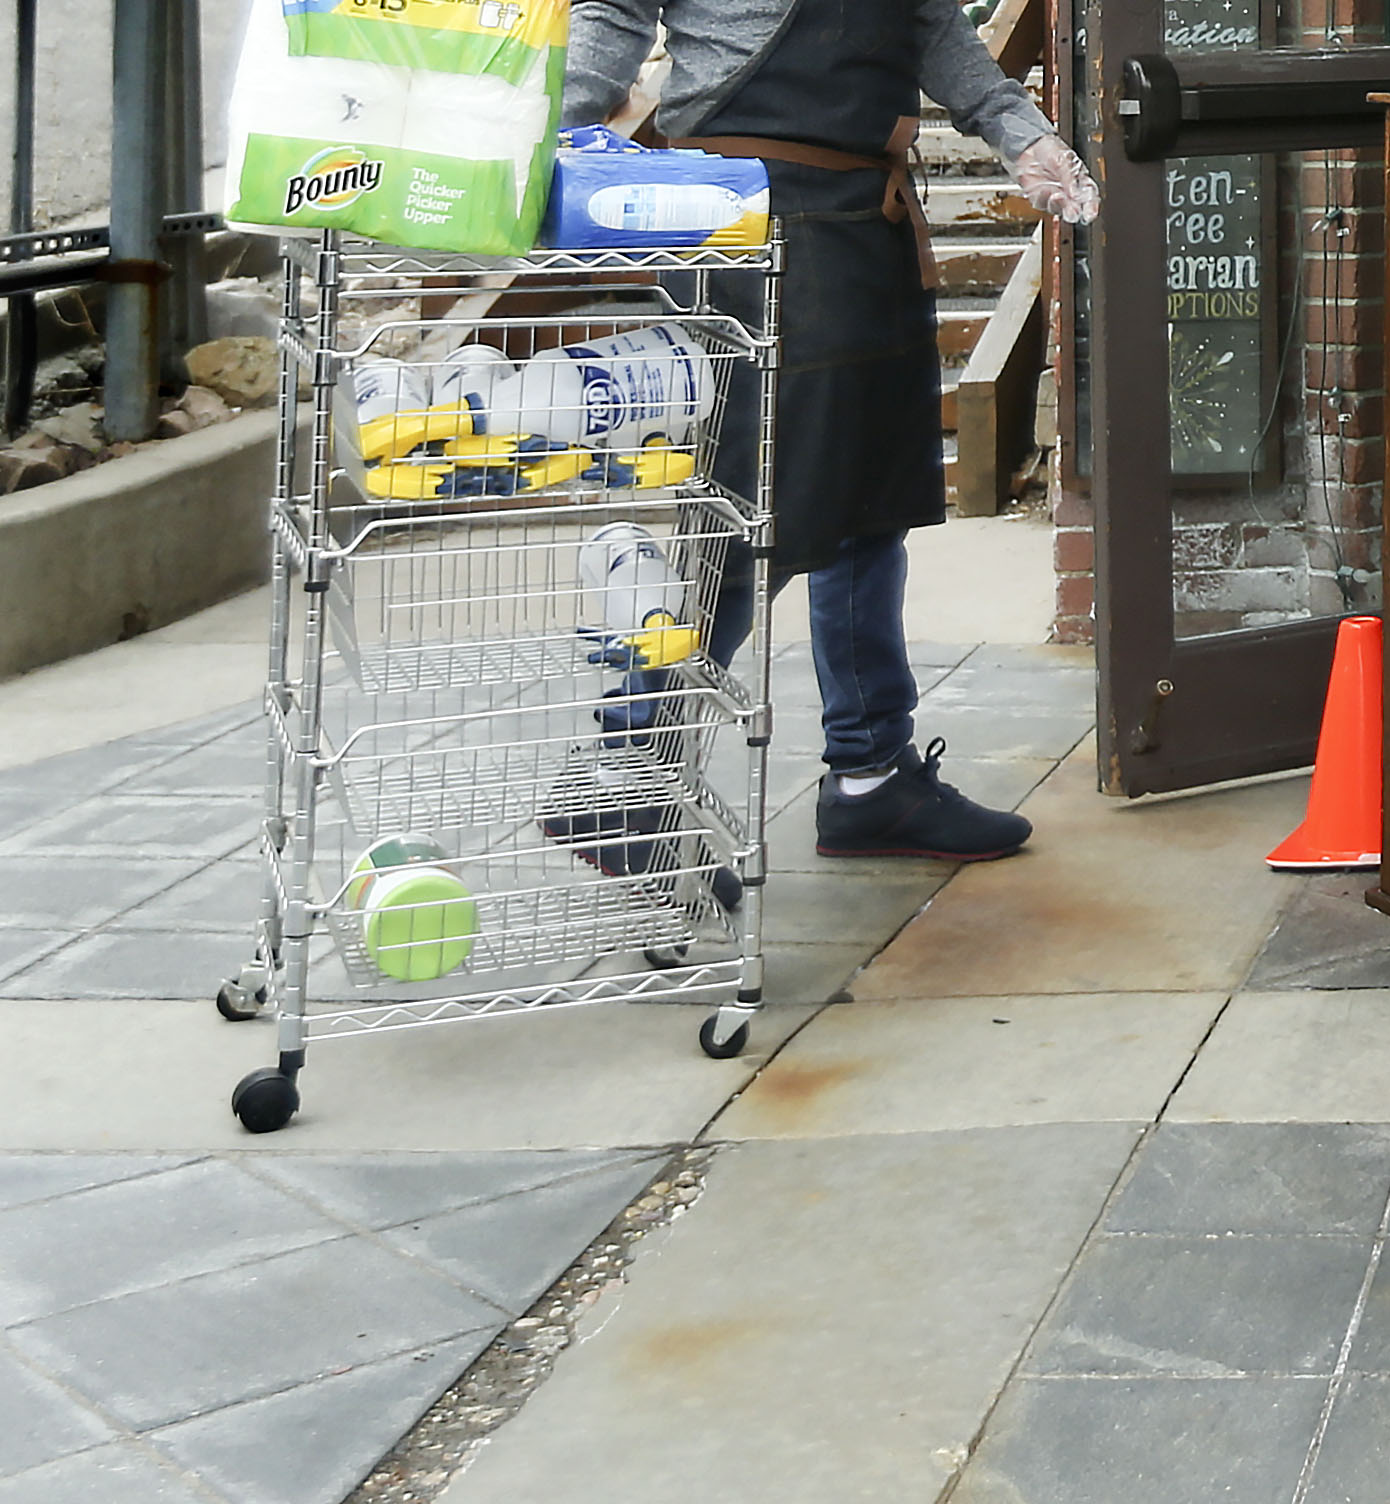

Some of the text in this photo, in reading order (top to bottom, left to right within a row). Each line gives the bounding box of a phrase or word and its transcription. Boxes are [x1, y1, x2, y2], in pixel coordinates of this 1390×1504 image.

[412, 167, 440, 183] The
[284, 158, 384, 215] Bounty
[409, 180, 466, 199] Quicker
[406, 194, 452, 212] Picker
[404, 207, 453, 225] Upper
[1168, 292, 1259, 319] PTIONS
